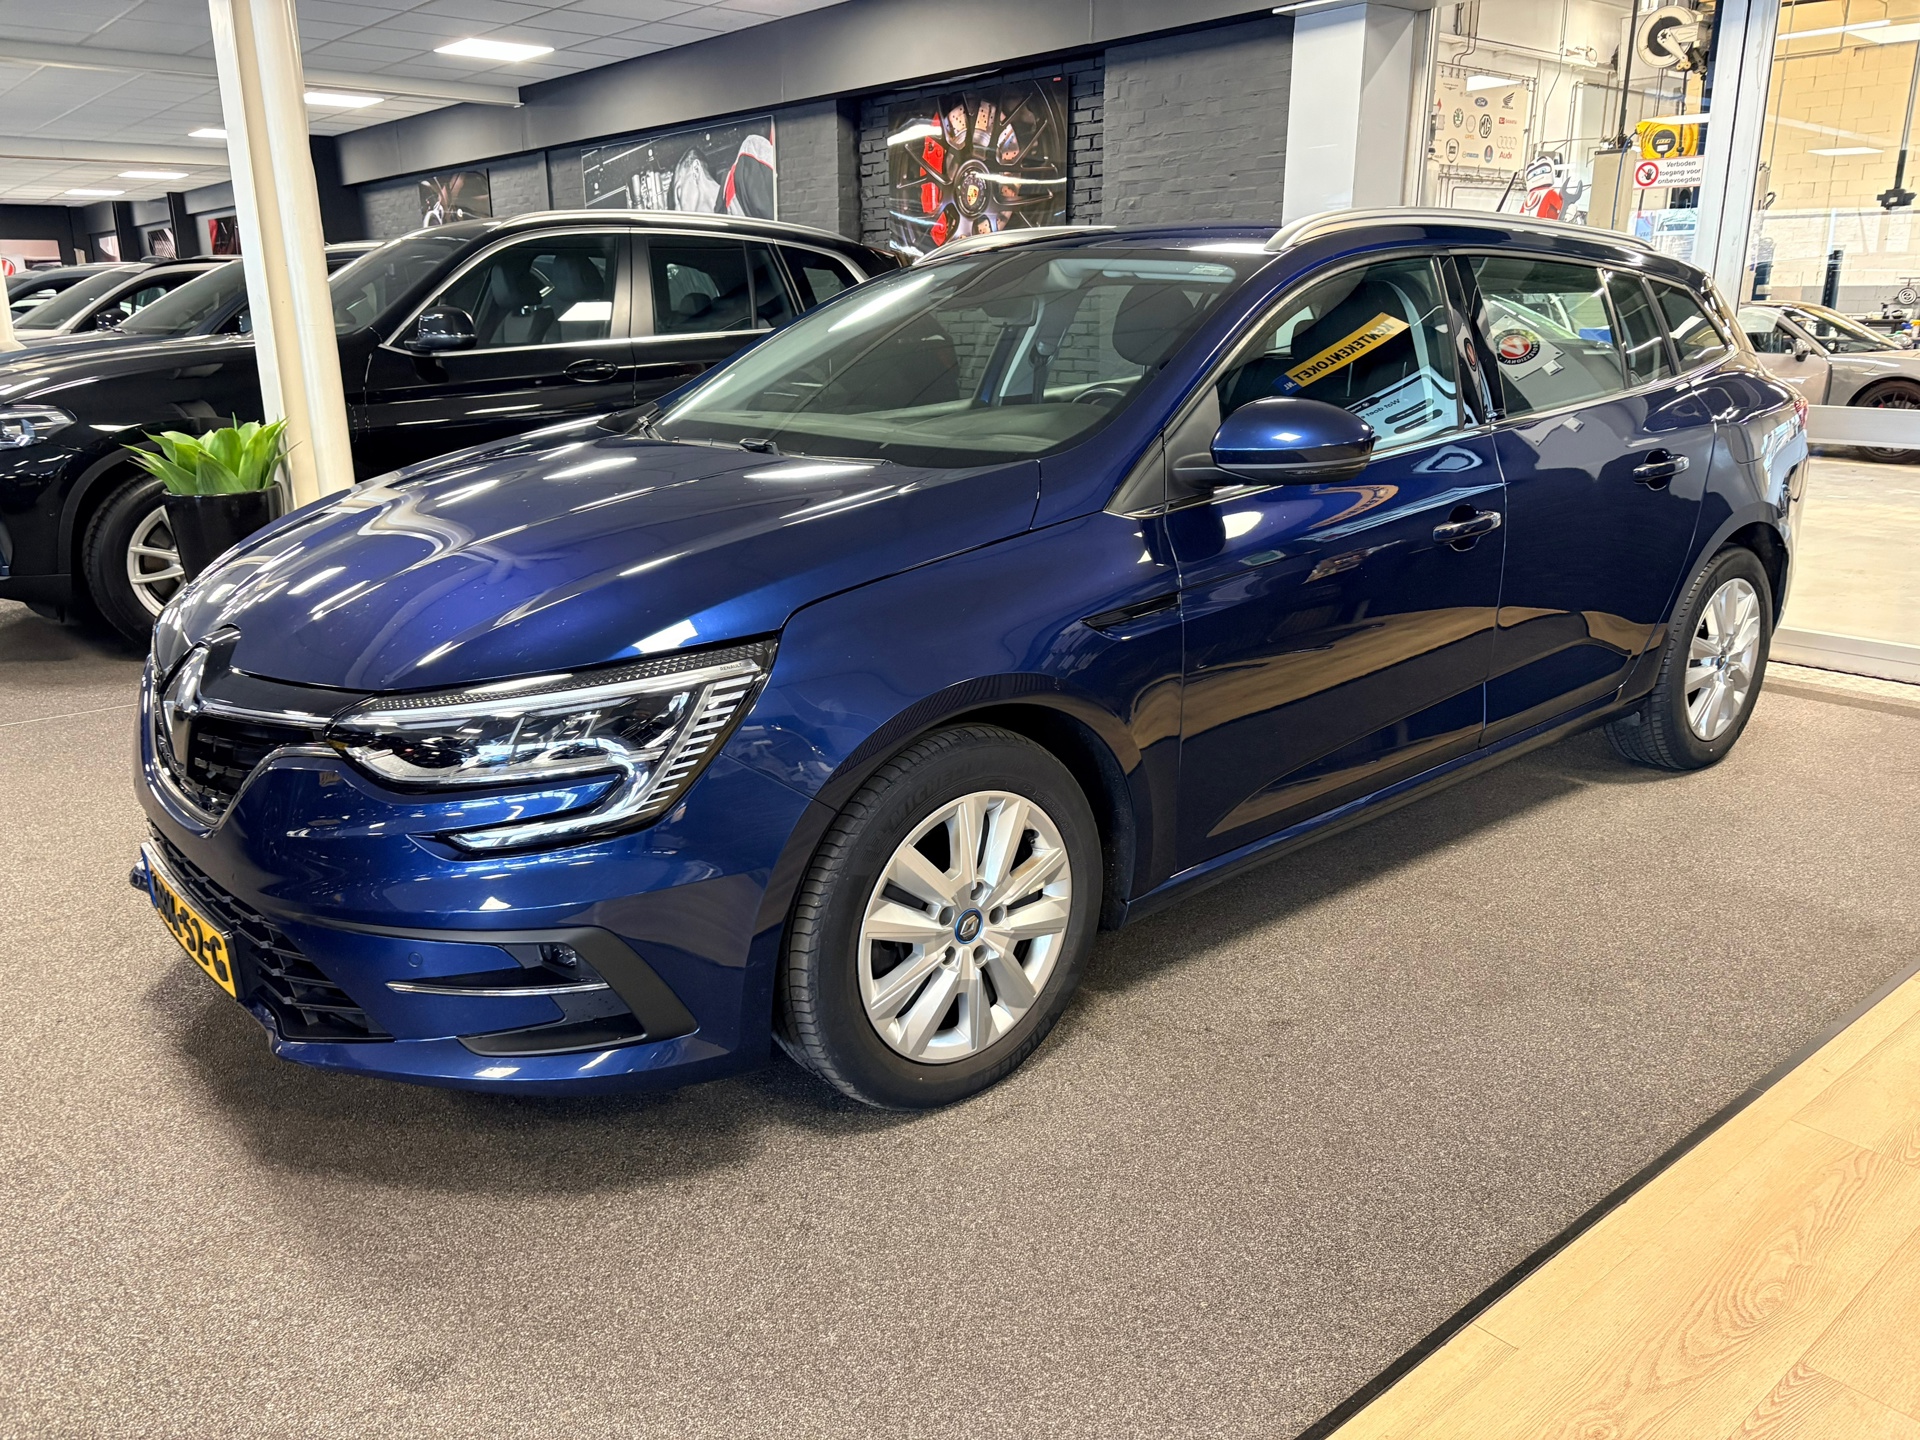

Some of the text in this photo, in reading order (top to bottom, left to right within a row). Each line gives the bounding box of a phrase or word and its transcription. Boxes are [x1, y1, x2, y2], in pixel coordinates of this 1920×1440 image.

[1499, 151, 1512, 160] Audi
[1659, 169, 1685, 177] toegang
[1658, 176, 1701, 184] onbevoegden
[719, 662, 742, 671] RENAULT
